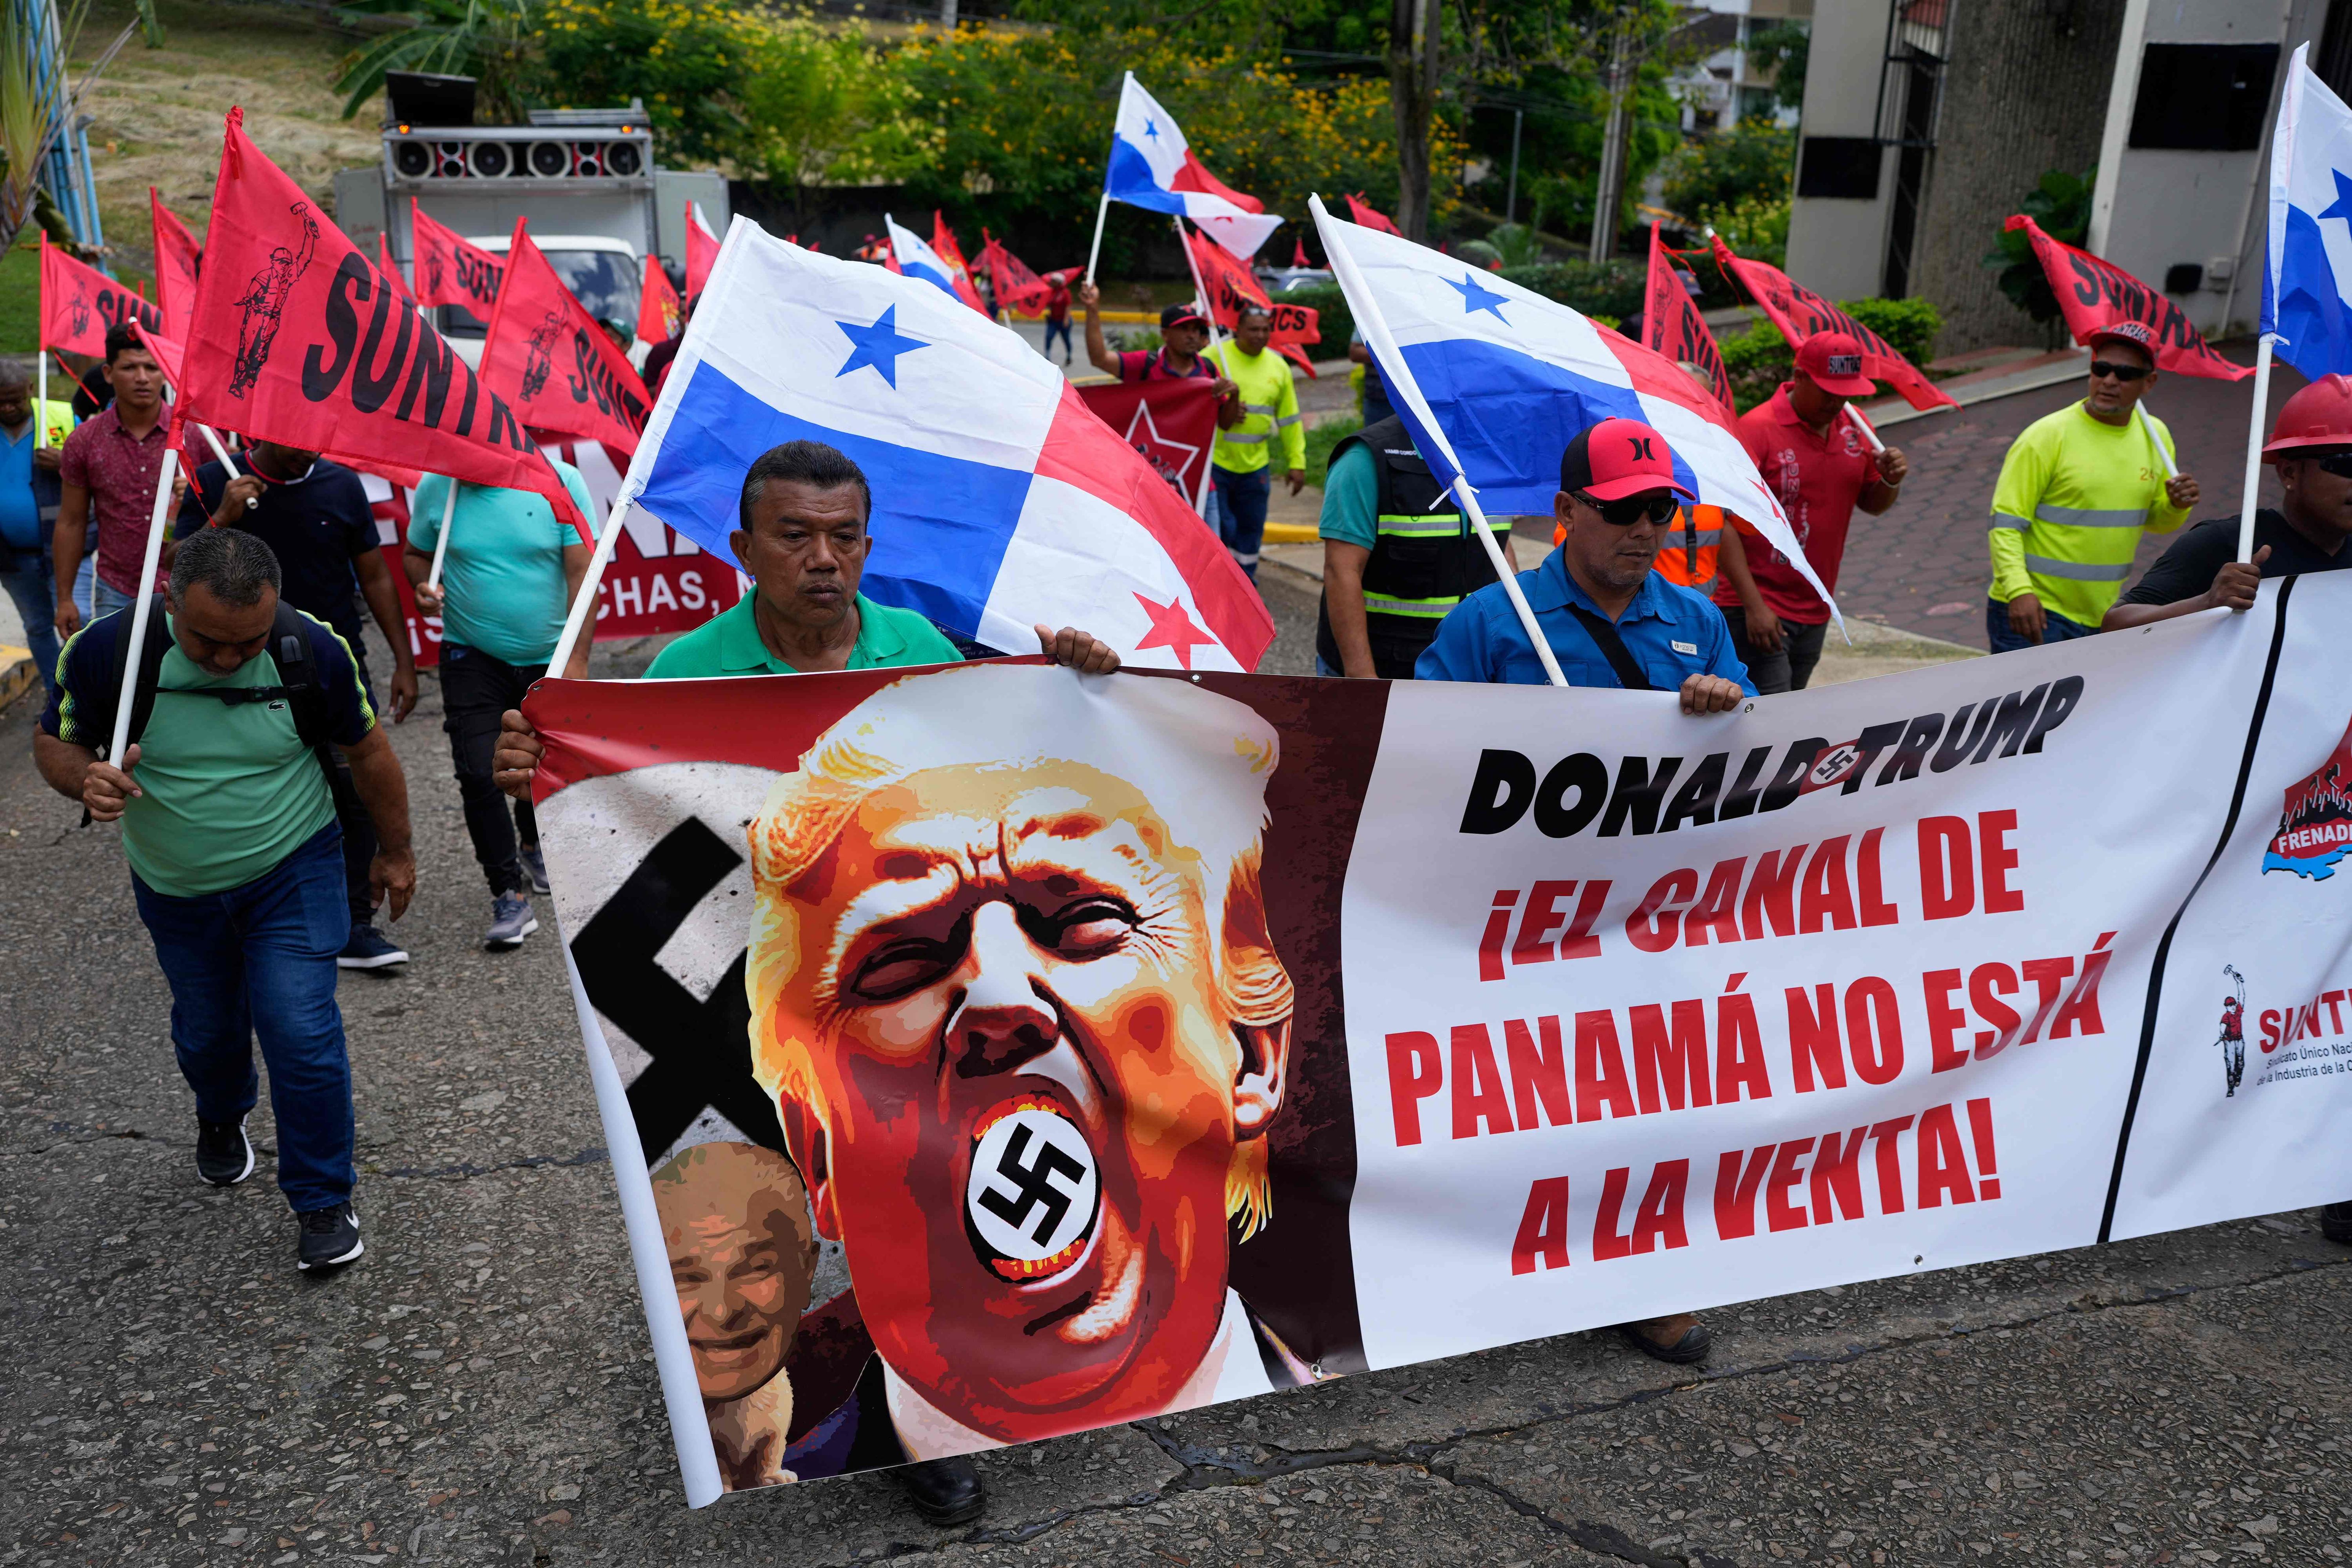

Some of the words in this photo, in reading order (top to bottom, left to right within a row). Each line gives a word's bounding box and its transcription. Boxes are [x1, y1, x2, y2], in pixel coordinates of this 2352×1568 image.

[1459, 737, 1829, 838] DONALD
[1840, 675, 2085, 796] TRUMP
[1479, 880, 1613, 982] ¡EL
[1626, 826, 1898, 953] CANAL
[1917, 809, 2024, 920] DE
[2278, 824, 2352, 853] FRENAD
[1385, 972, 1771, 1147] PANAMÁ
[1785, 976, 1904, 1094] NO
[1923, 931, 2118, 1075] ESTÁ
[2259, 988, 2352, 1054] SUNT
[2275, 1064, 2318, 1081] Industria
[2321, 1063, 2334, 1076] de
[2335, 1062, 2345, 1073] la
[2300, 1045, 2329, 1059] Único
[1512, 1176, 1570, 1276] A
[1592, 1158, 1689, 1261] LA
[1714, 1098, 2001, 1241] VENTA!
